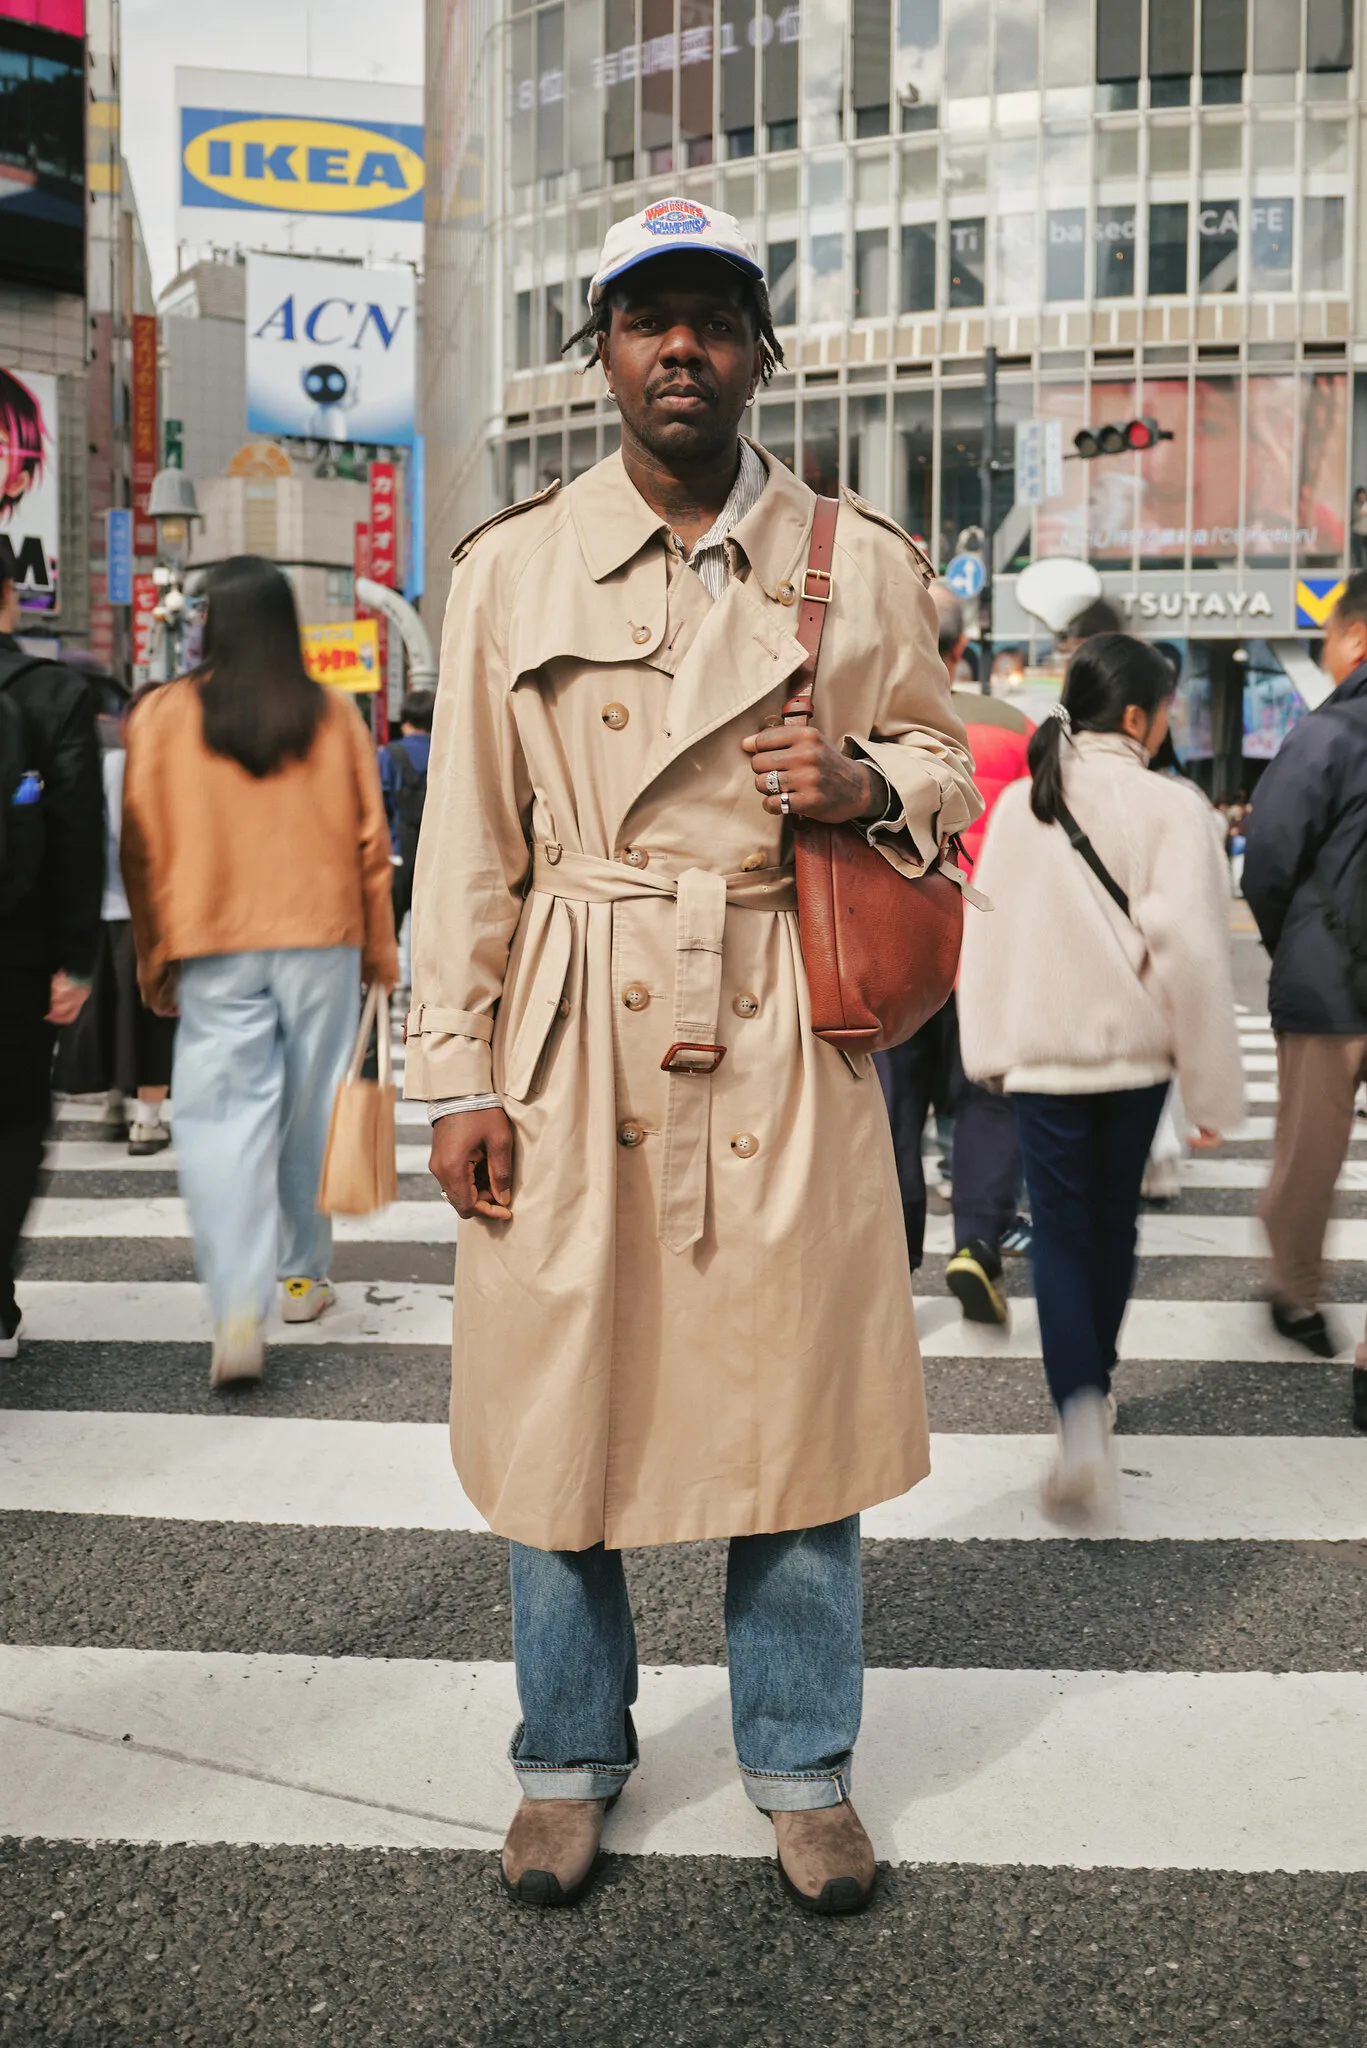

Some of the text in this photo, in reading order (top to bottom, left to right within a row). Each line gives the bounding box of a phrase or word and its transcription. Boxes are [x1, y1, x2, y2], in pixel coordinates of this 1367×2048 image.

[207, 138, 410, 191] IKEA
[652, 219, 703, 234] CHAMPIONS
[1050, 219, 1139, 243] based
[1198, 206, 1284, 236] CAFE
[254, 293, 409, 350] ACN
[372, 475, 392, 578] カラオケ
[1118, 591, 1273, 618] TSUTAYA
